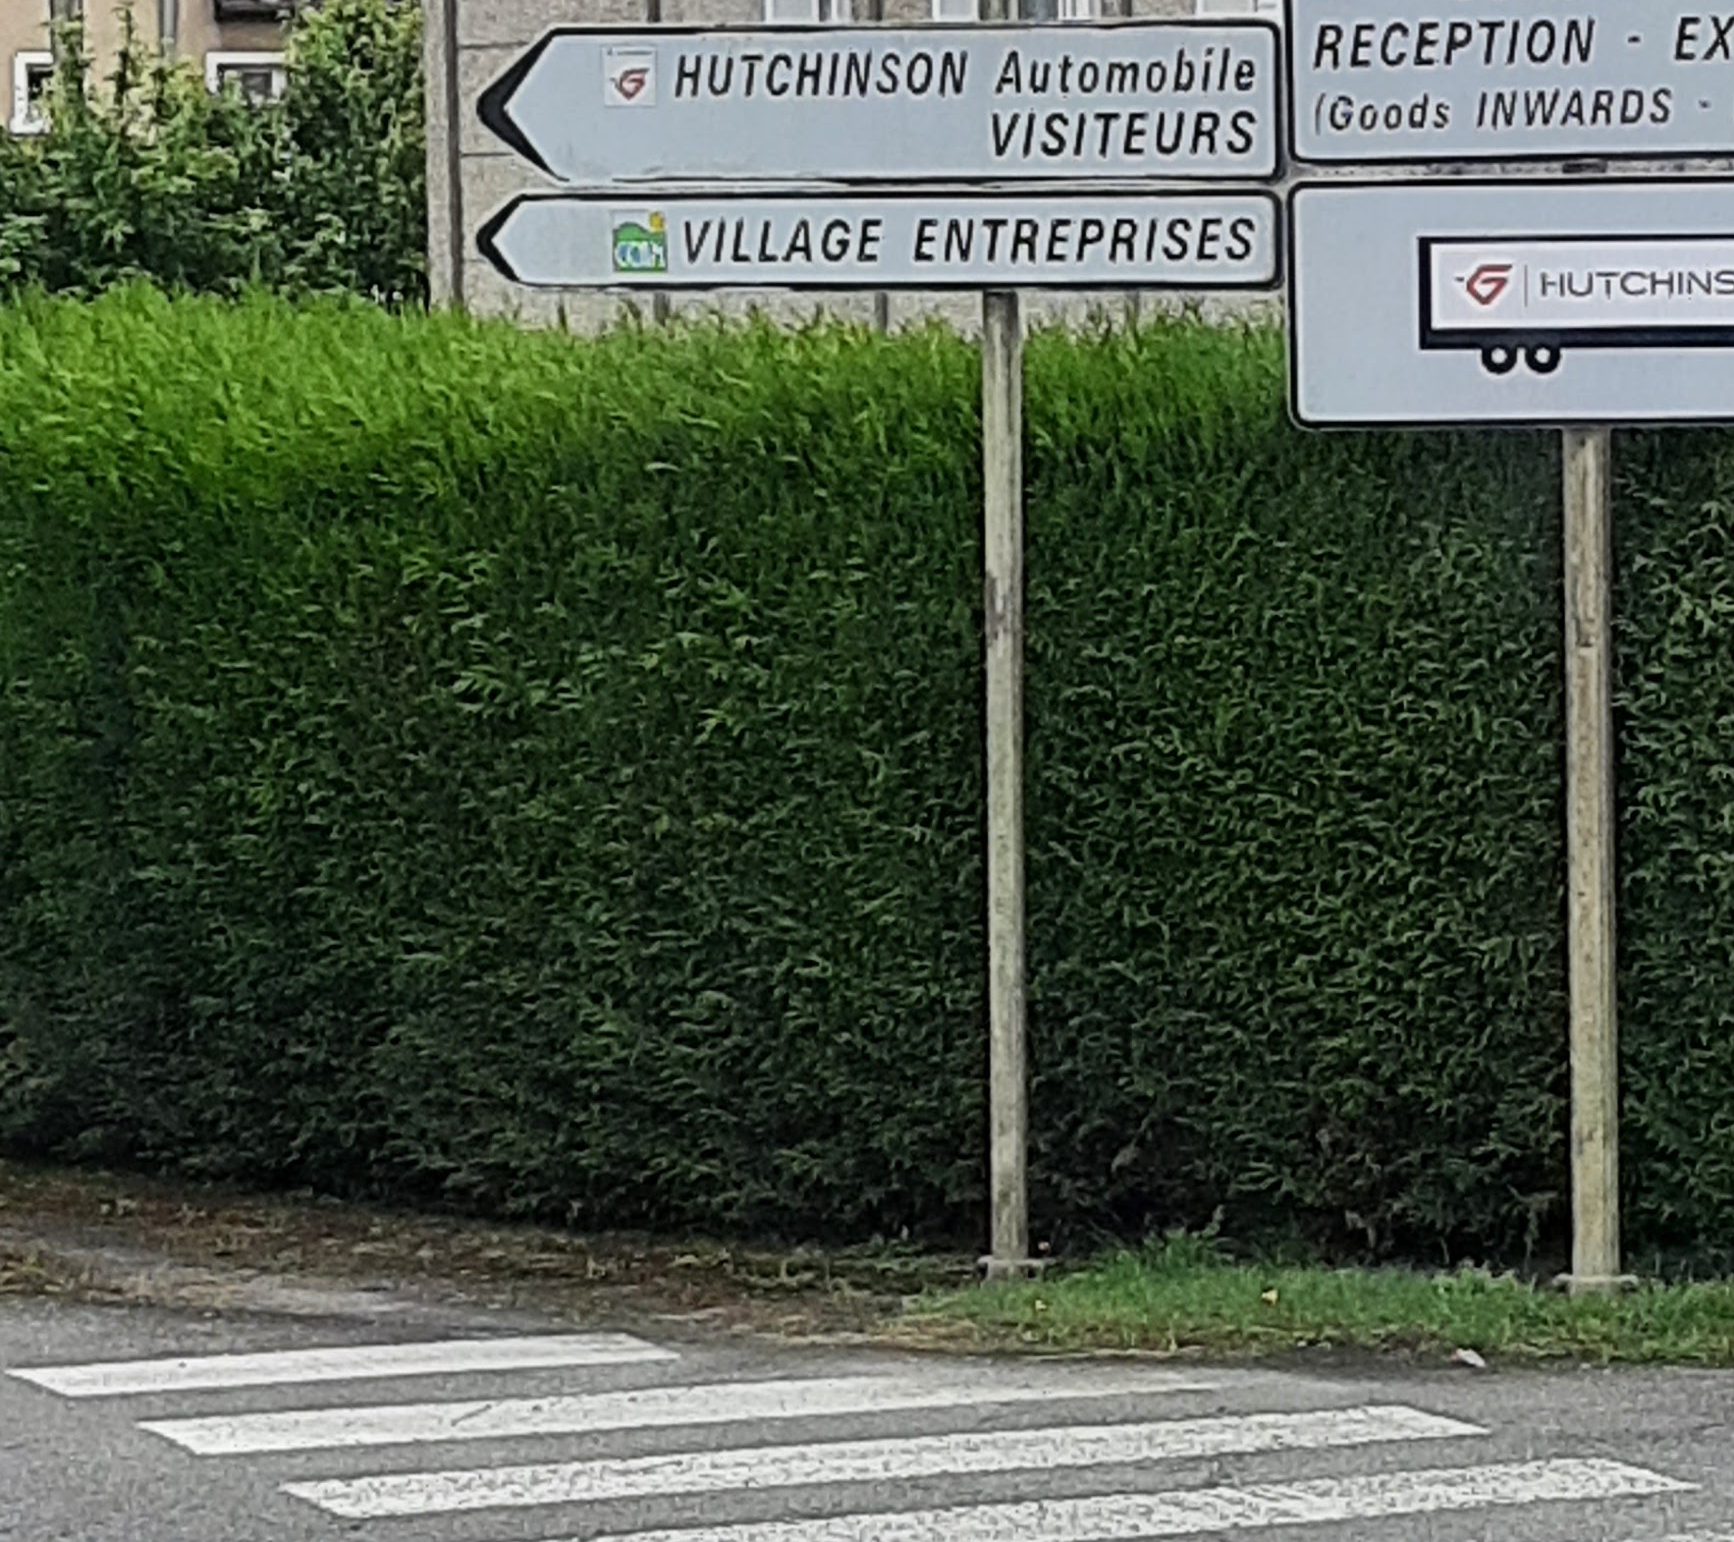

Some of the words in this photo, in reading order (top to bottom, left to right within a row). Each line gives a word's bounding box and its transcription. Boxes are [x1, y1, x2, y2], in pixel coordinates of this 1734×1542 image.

[1313, 15, 1596, 70] RECEPTION
[675, 50, 968, 98] HUTCHINSON
[995, 47, 1256, 95] Automobile
[991, 110, 1257, 157] VISITEURS
[1314, 92, 1451, 135] (Goods
[1475, 88, 1673, 130] INWARDS
[684, 216, 883, 264] VILLAGE
[913, 216, 1256, 264] ENTREPRISES
